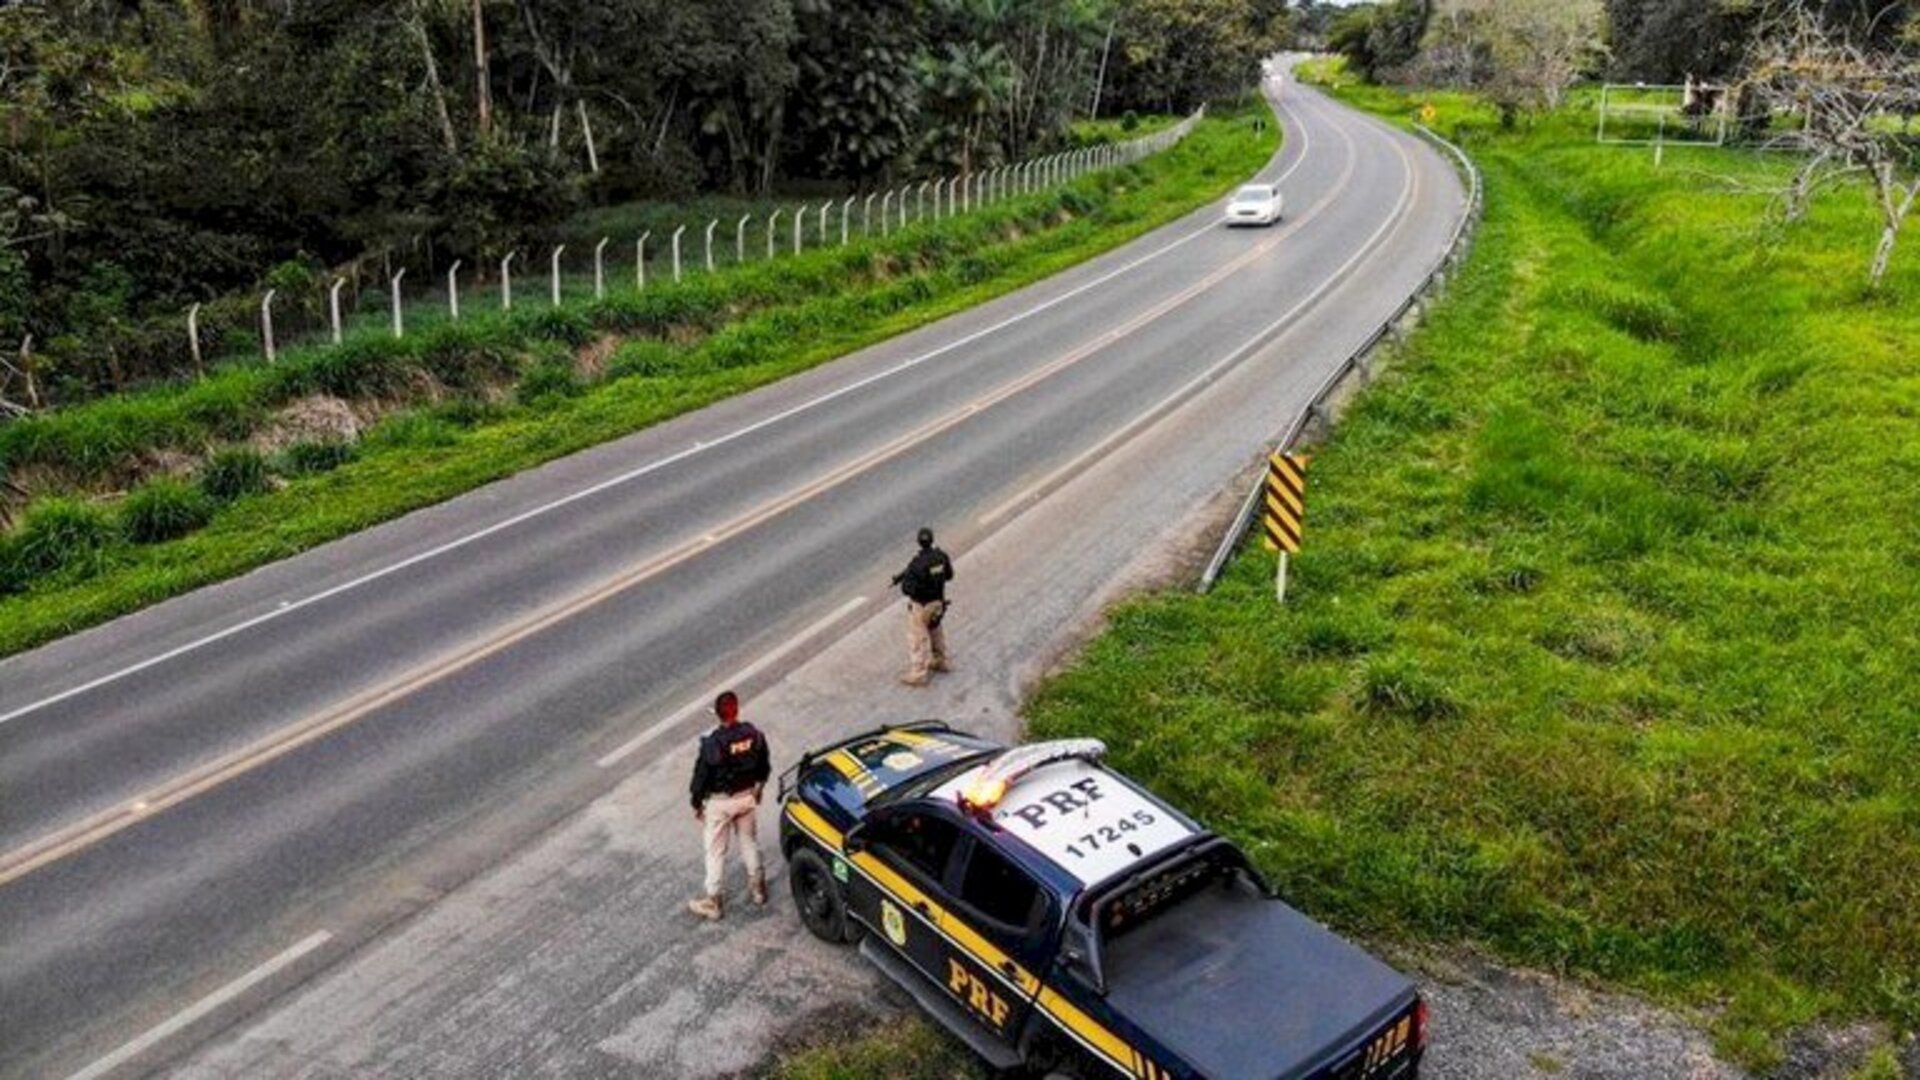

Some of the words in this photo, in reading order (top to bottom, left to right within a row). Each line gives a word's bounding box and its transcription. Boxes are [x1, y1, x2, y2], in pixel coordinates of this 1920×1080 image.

[1013, 776, 1104, 829] PRF
[1065, 809, 1156, 859] 17245
[948, 957, 1009, 1028] PRF
